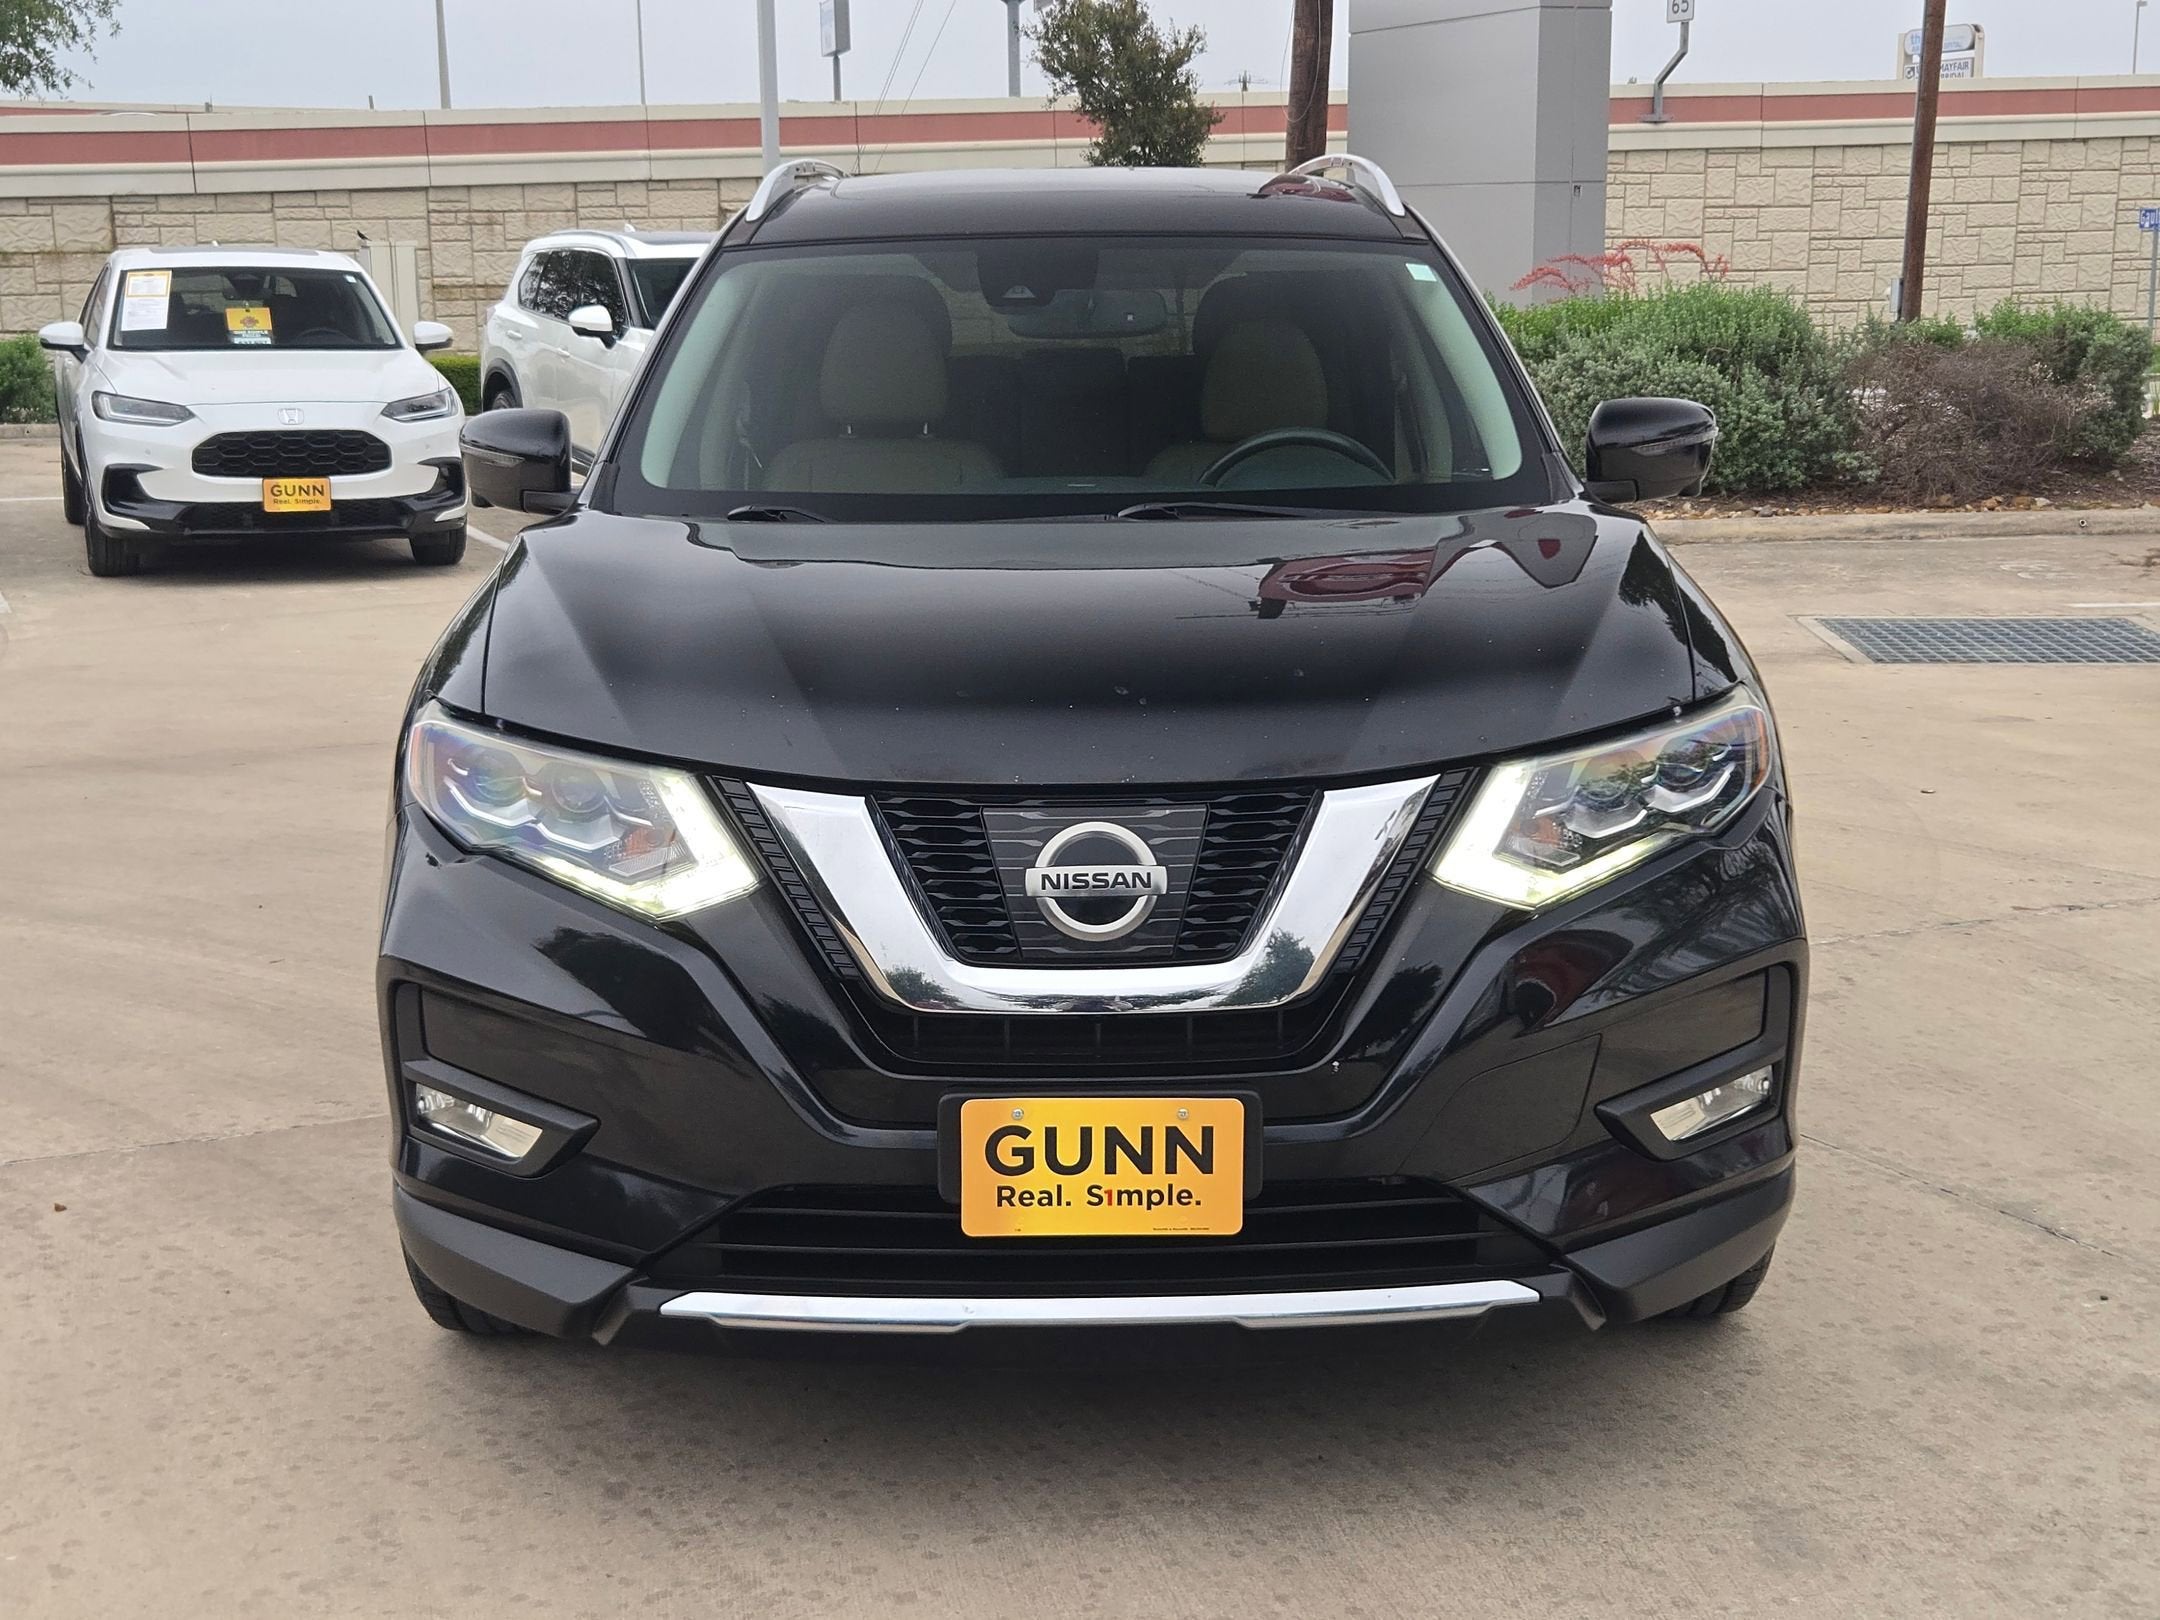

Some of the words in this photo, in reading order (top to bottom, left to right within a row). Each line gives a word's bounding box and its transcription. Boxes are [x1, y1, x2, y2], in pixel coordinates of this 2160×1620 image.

[1672, 0, 1689, 14] 65
[270, 485, 325, 497] GUNN
[1041, 872, 1152, 890] NISSAN
[985, 1125, 1214, 1176] GUNN
[996, 1184, 1072, 1207] Real.
